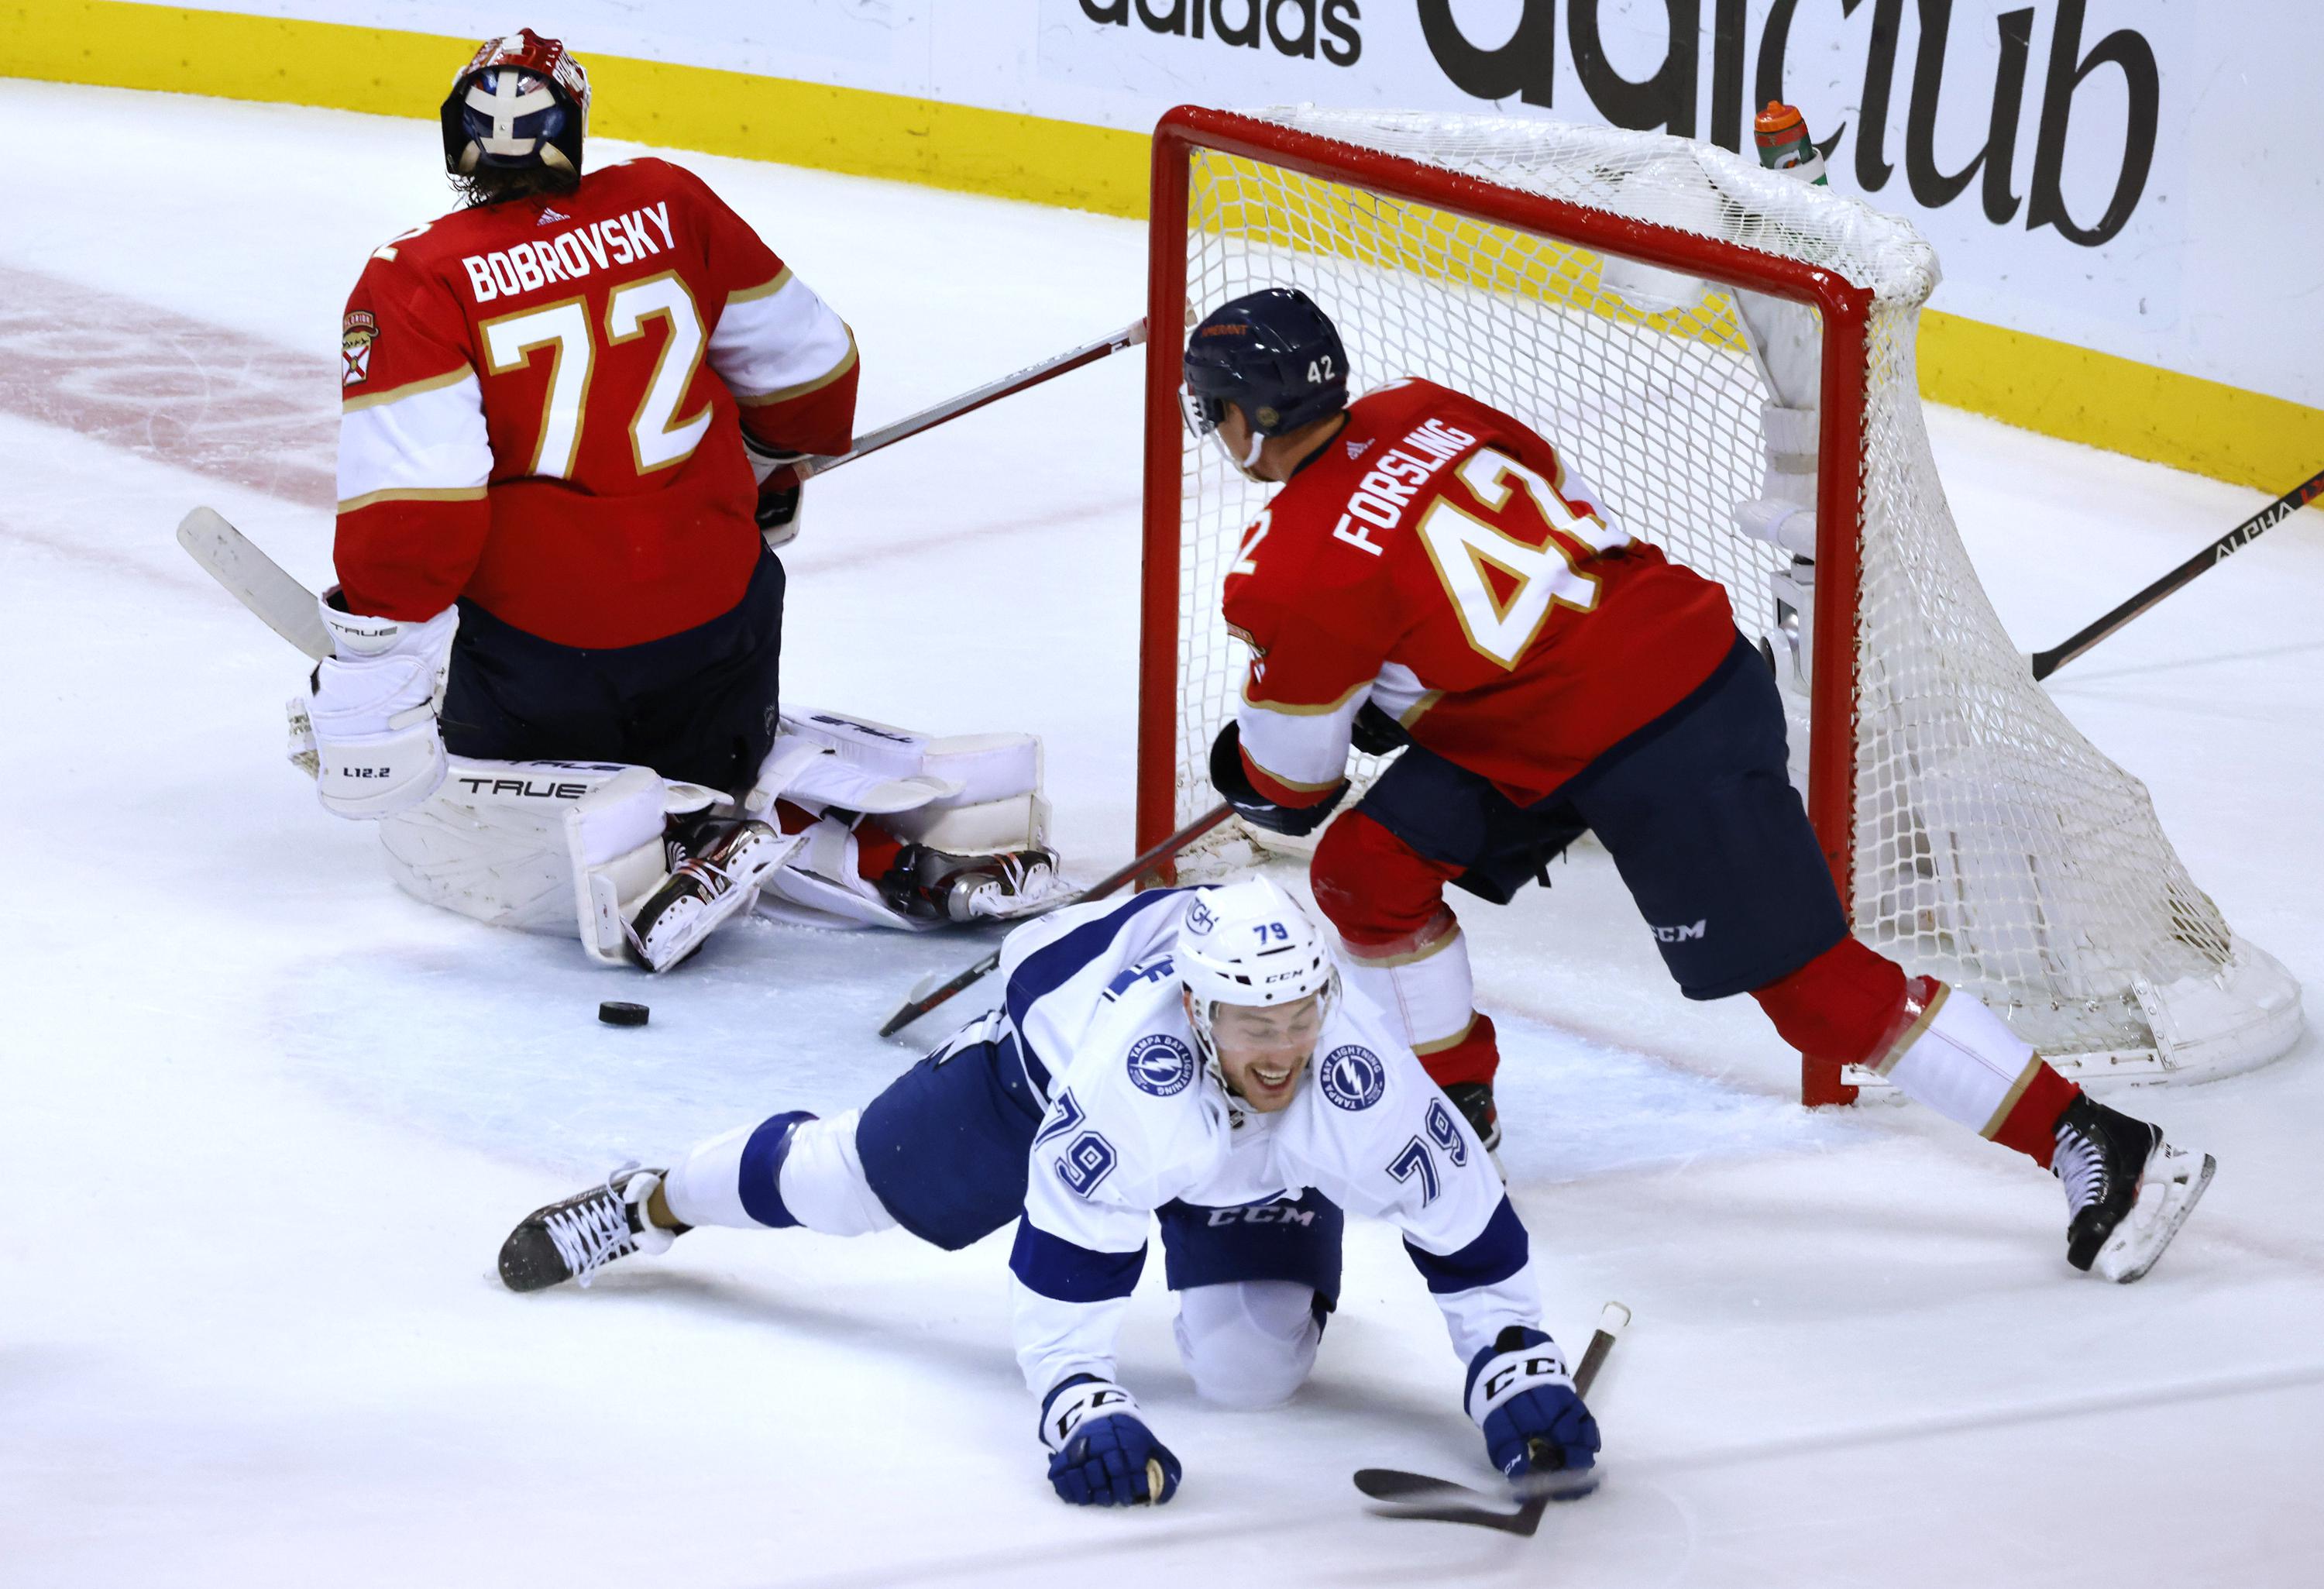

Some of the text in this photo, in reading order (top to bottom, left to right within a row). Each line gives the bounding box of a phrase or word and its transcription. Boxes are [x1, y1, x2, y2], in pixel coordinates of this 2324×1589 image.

[462, 201, 676, 304] BOBROVSKY
[478, 269, 713, 479] 72
[1307, 355, 1336, 383] 42
[1333, 418, 1477, 557] FORSLING
[2215, 501, 2297, 564] ALPHA
[1415, 445, 1611, 672] 42
[330, 621, 397, 637] TRUE
[343, 767, 390, 779] L12.2
[459, 778, 587, 800] TRUE
[1253, 922, 1289, 945] 79
[1265, 969, 1304, 984] CCM
[1129, 1035, 1161, 1058] TAMPA
[1164, 1036, 1185, 1051] BAY
[1156, 1052, 1193, 1095] LIGHTNING
[1322, 1046, 1382, 1109] TAMPA BAY LIGHTNING
[1033, 1085, 1118, 1201] 79
[1384, 1096, 1469, 1209] 79
[1207, 1206, 1315, 1227] CCM
[1055, 1390, 1141, 1441] CC
